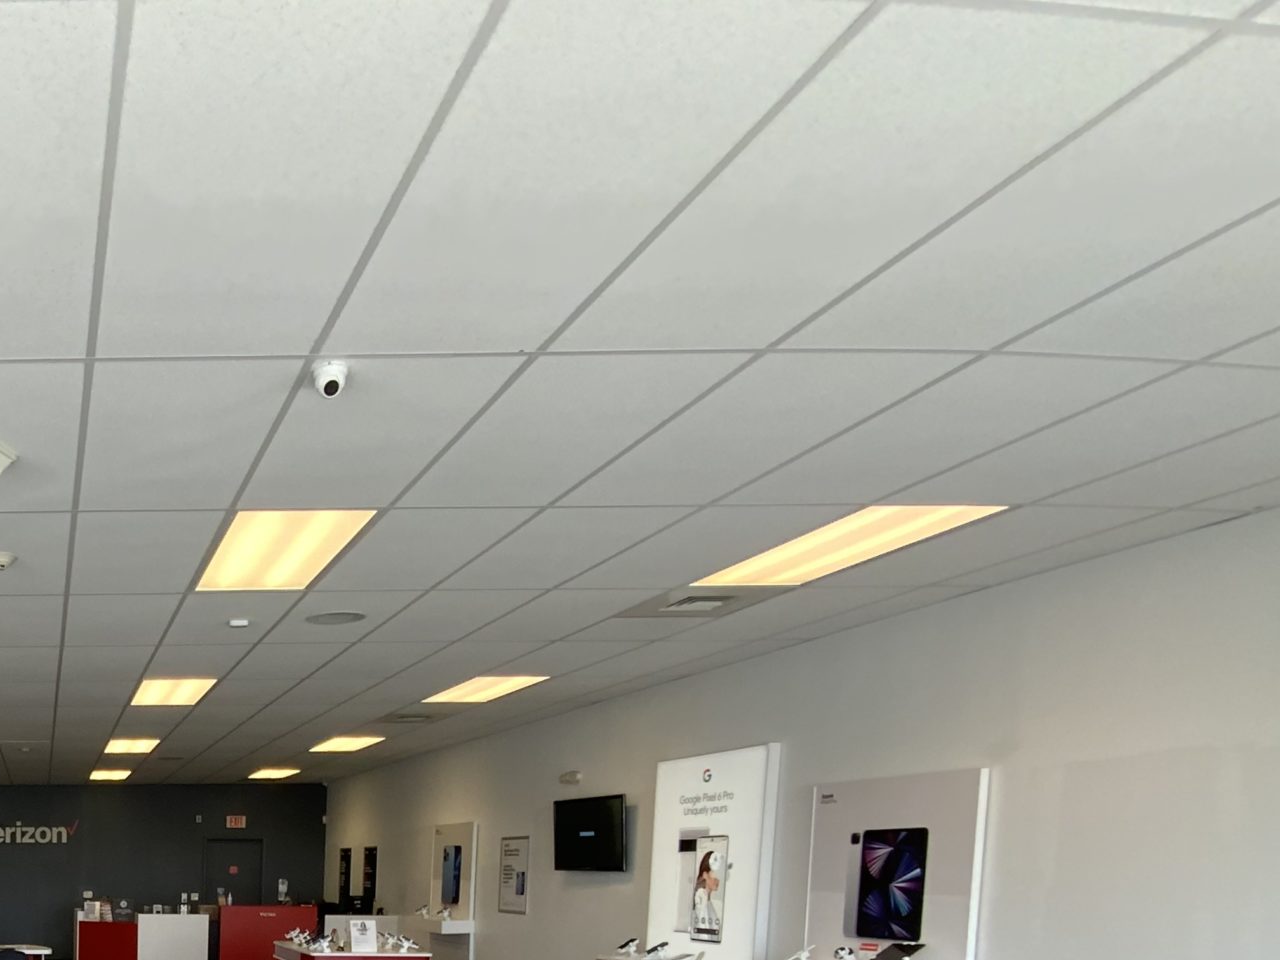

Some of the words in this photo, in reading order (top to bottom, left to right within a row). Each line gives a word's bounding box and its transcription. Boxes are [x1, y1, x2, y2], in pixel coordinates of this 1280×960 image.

[679, 795, 701, 806] Google
[702, 792, 717, 802] Pixel
[723, 790, 734, 801] Pro
[683, 805, 709, 816] Uniquely
[709, 805, 728, 816] yours
